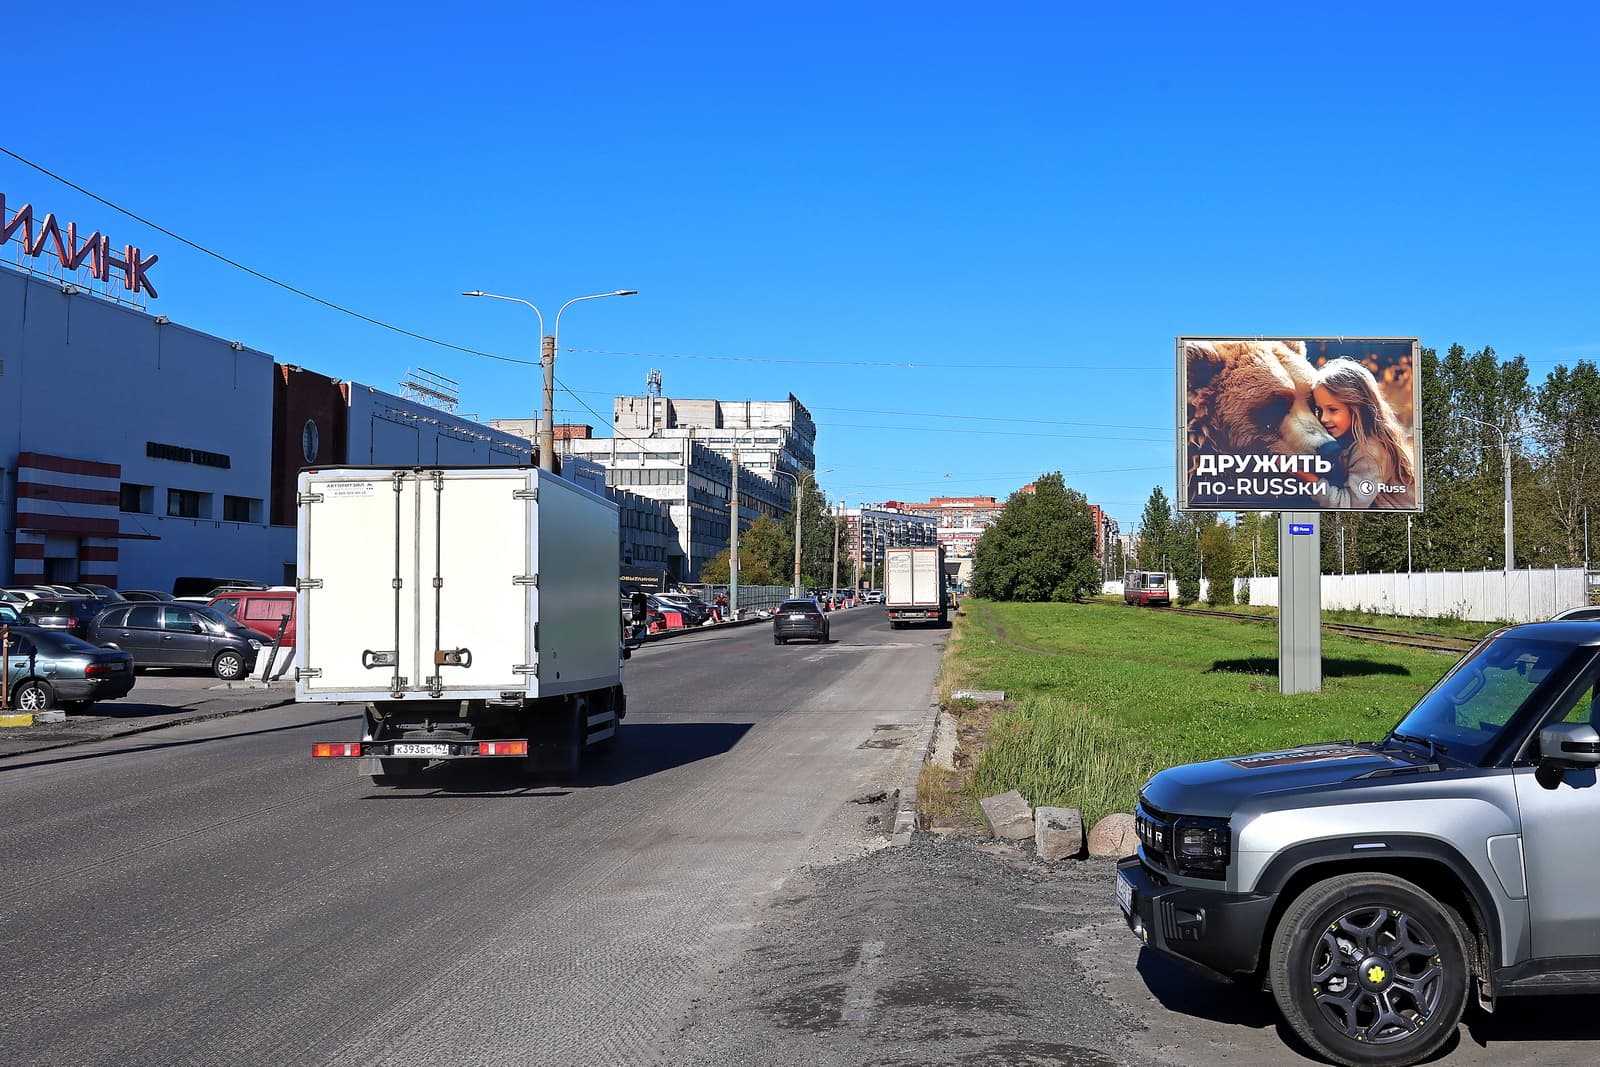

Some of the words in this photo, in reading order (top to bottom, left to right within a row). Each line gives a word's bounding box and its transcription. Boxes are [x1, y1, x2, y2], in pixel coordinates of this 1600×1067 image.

[1196, 454, 1332, 476] ДРУЖИТЬ
[1197, 478, 1327, 496] по-RUSSки
[1377, 483, 1407, 494] Russ
